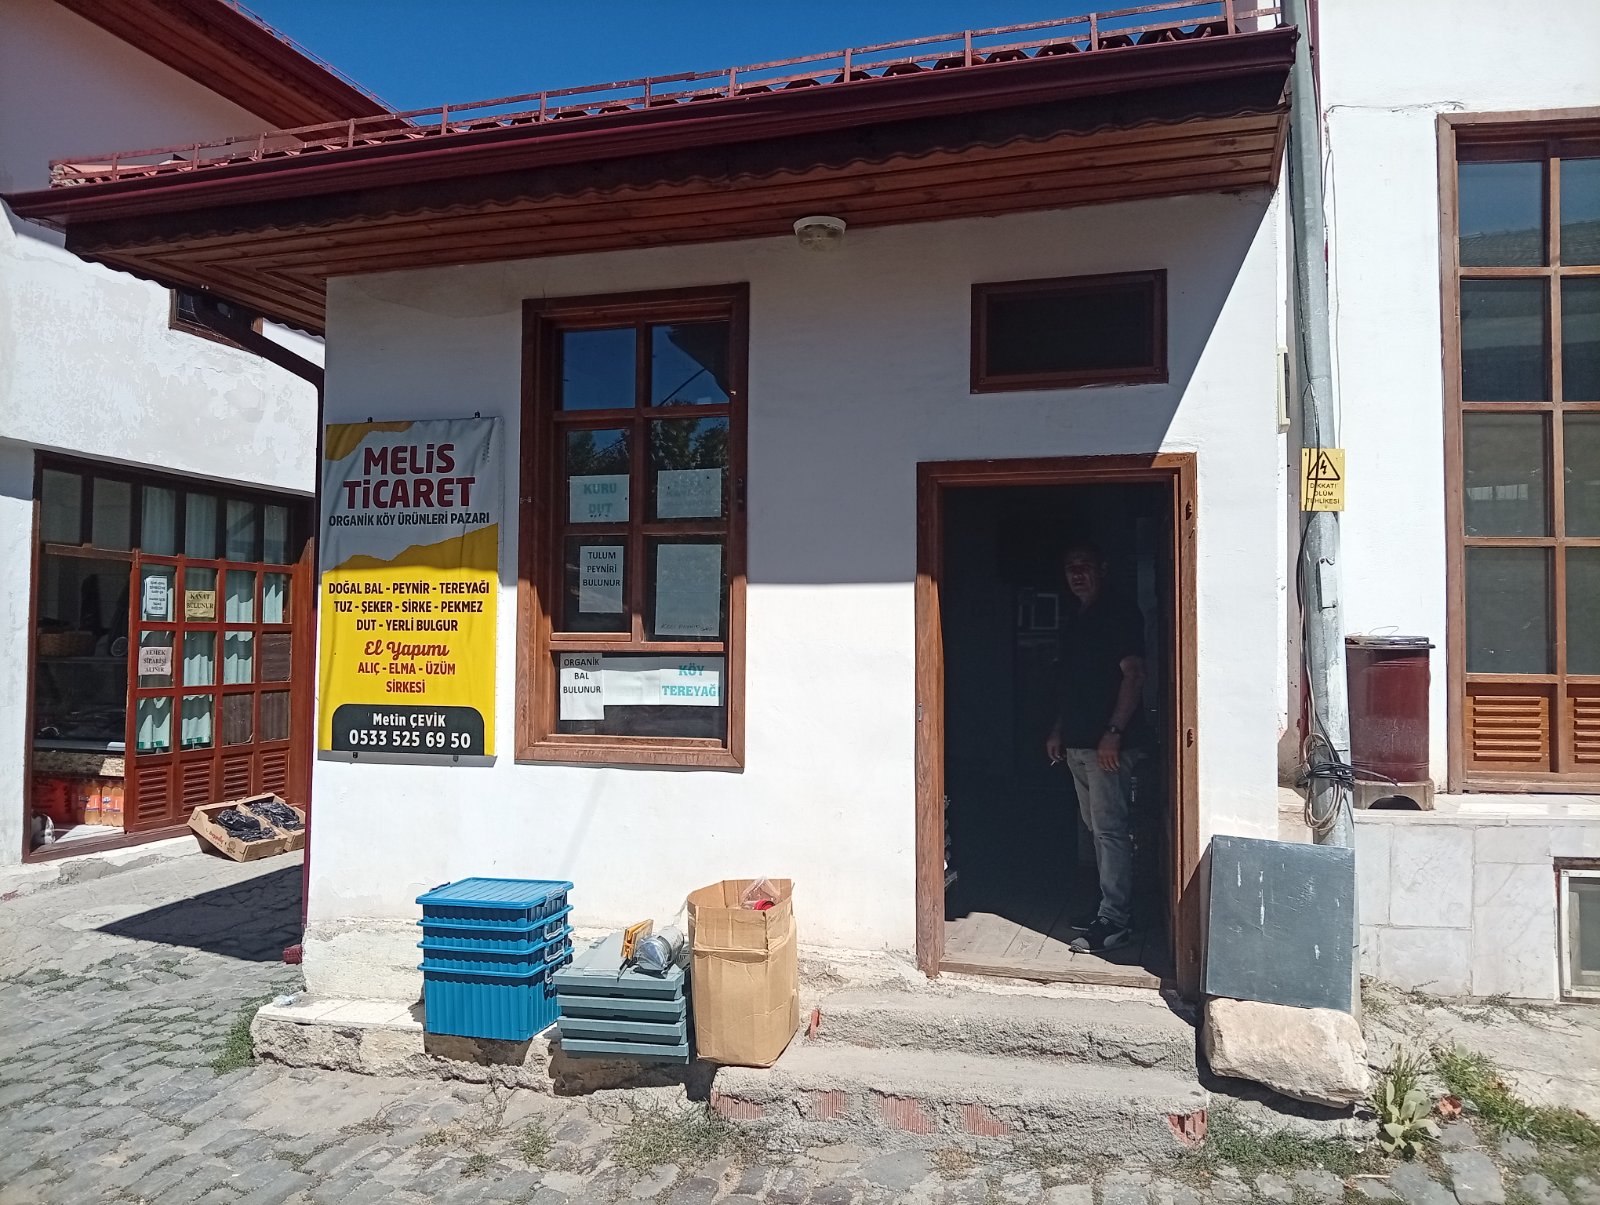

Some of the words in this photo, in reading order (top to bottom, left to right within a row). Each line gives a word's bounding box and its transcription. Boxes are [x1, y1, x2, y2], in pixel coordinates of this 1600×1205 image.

[584, 483, 616, 494] KURU
[329, 512, 374, 526] ORGANİK
[376, 513, 394, 526] KÖY
[398, 511, 448, 525] ÜRÜNLERİ
[451, 512, 489, 524] PAZARI
[587, 564, 617, 573] PEYNİRİ
[329, 580, 362, 594] DOĞAL
[365, 583, 383, 594] BAL
[393, 580, 429, 594] PEYNİR
[440, 580, 489, 594] TEREYAĞI
[334, 601, 352, 612] TUZ
[362, 601, 392, 614] ŞEKER
[402, 599, 431, 612] SİRKE
[441, 601, 483, 612] PEKMEZ
[357, 620, 376, 631] DUT
[386, 617, 414, 631] YERLİ
[417, 620, 458, 631] BULGUR
[365, 640, 383, 656] El
[387, 642, 450, 662] Yapımı
[564, 656, 600, 666] ORGANİK
[358, 662, 380, 677] ALIÇ
[389, 663, 416, 675] ELMA
[426, 661, 455, 675] ÜZÜM
[678, 662, 704, 676] KÖY
[386, 679, 425, 693] SİRKESİ
[373, 713, 406, 726] Metin
[410, 712, 446, 729] ÇEVİK
[349, 730, 387, 746] 0533
[392, 731, 420, 747] 525
[425, 732, 445, 747] 69
[451, 733, 470, 748] 50
